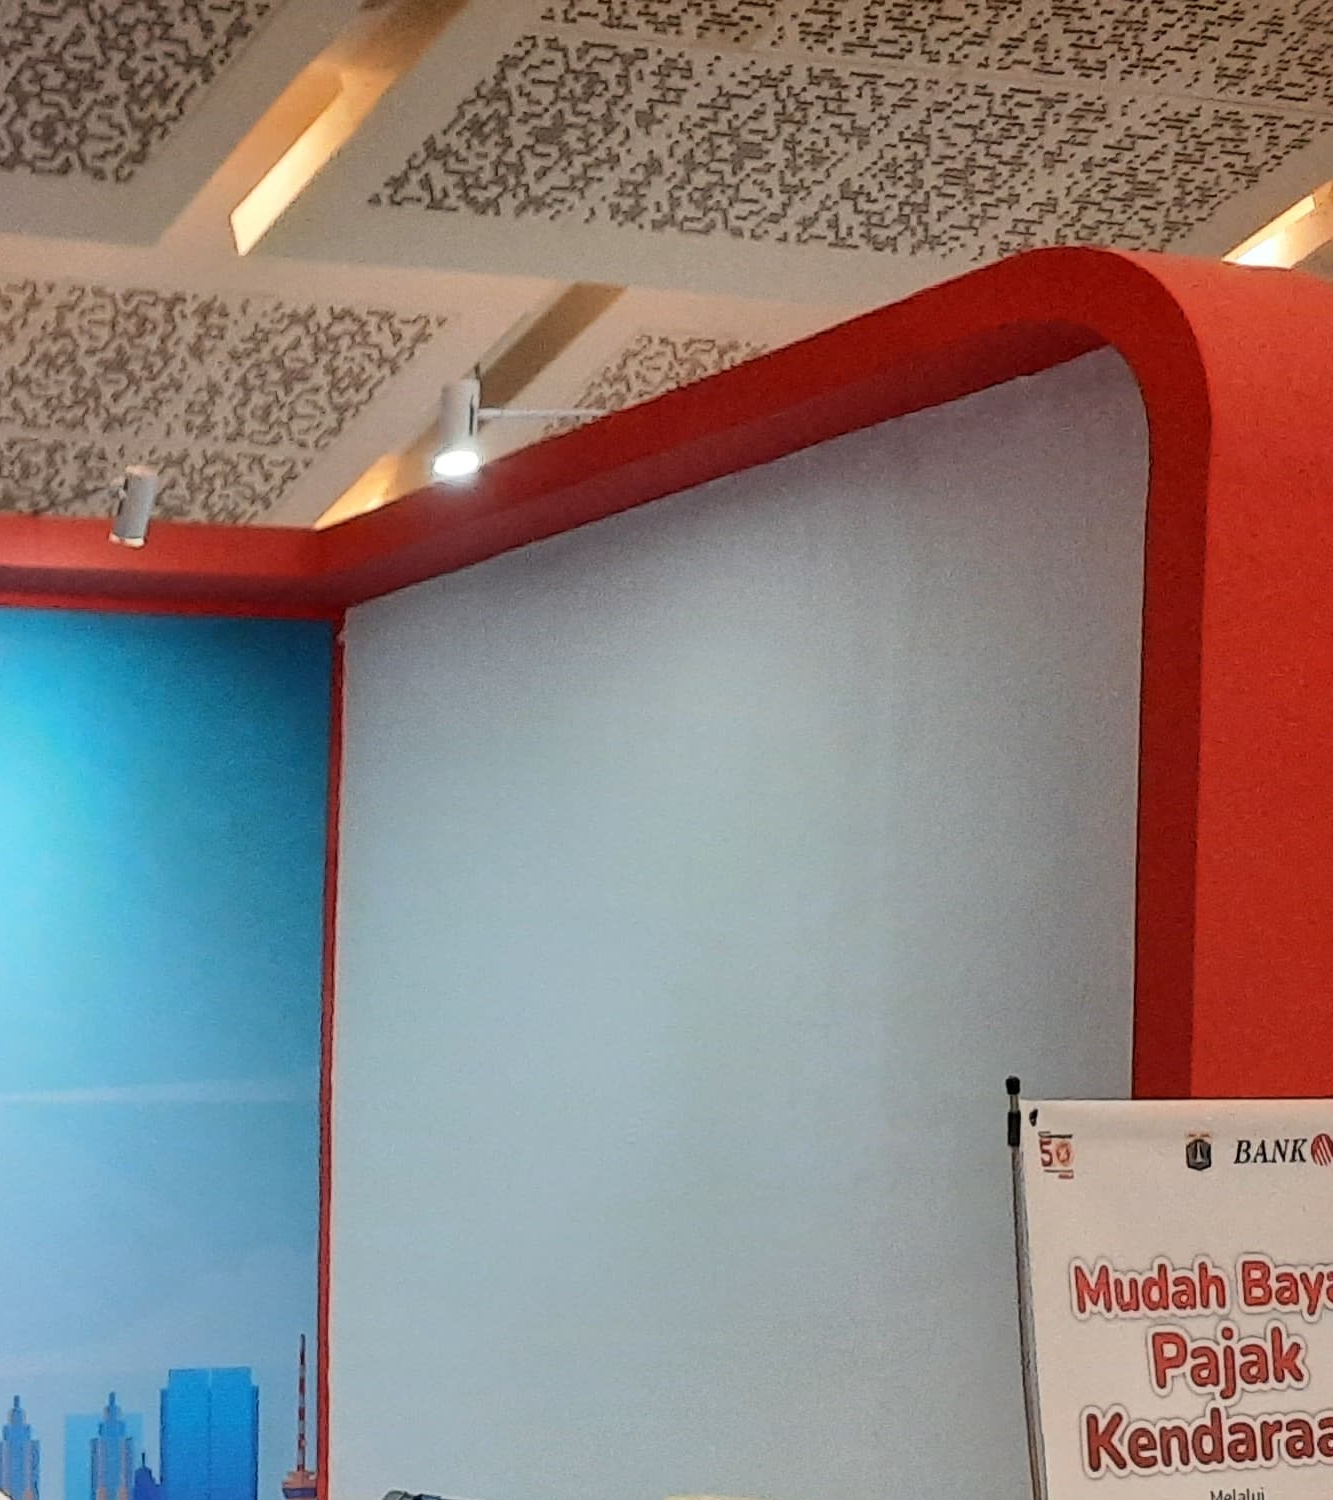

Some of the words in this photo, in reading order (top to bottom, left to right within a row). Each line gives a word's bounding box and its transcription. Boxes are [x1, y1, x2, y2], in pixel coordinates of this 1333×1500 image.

[1233, 1138, 1307, 1164] BANK
[1074, 1261, 1226, 1313] Mudah
[1241, 1260, 1333, 1316] Bay
[1151, 1326, 1304, 1399] Pajak
